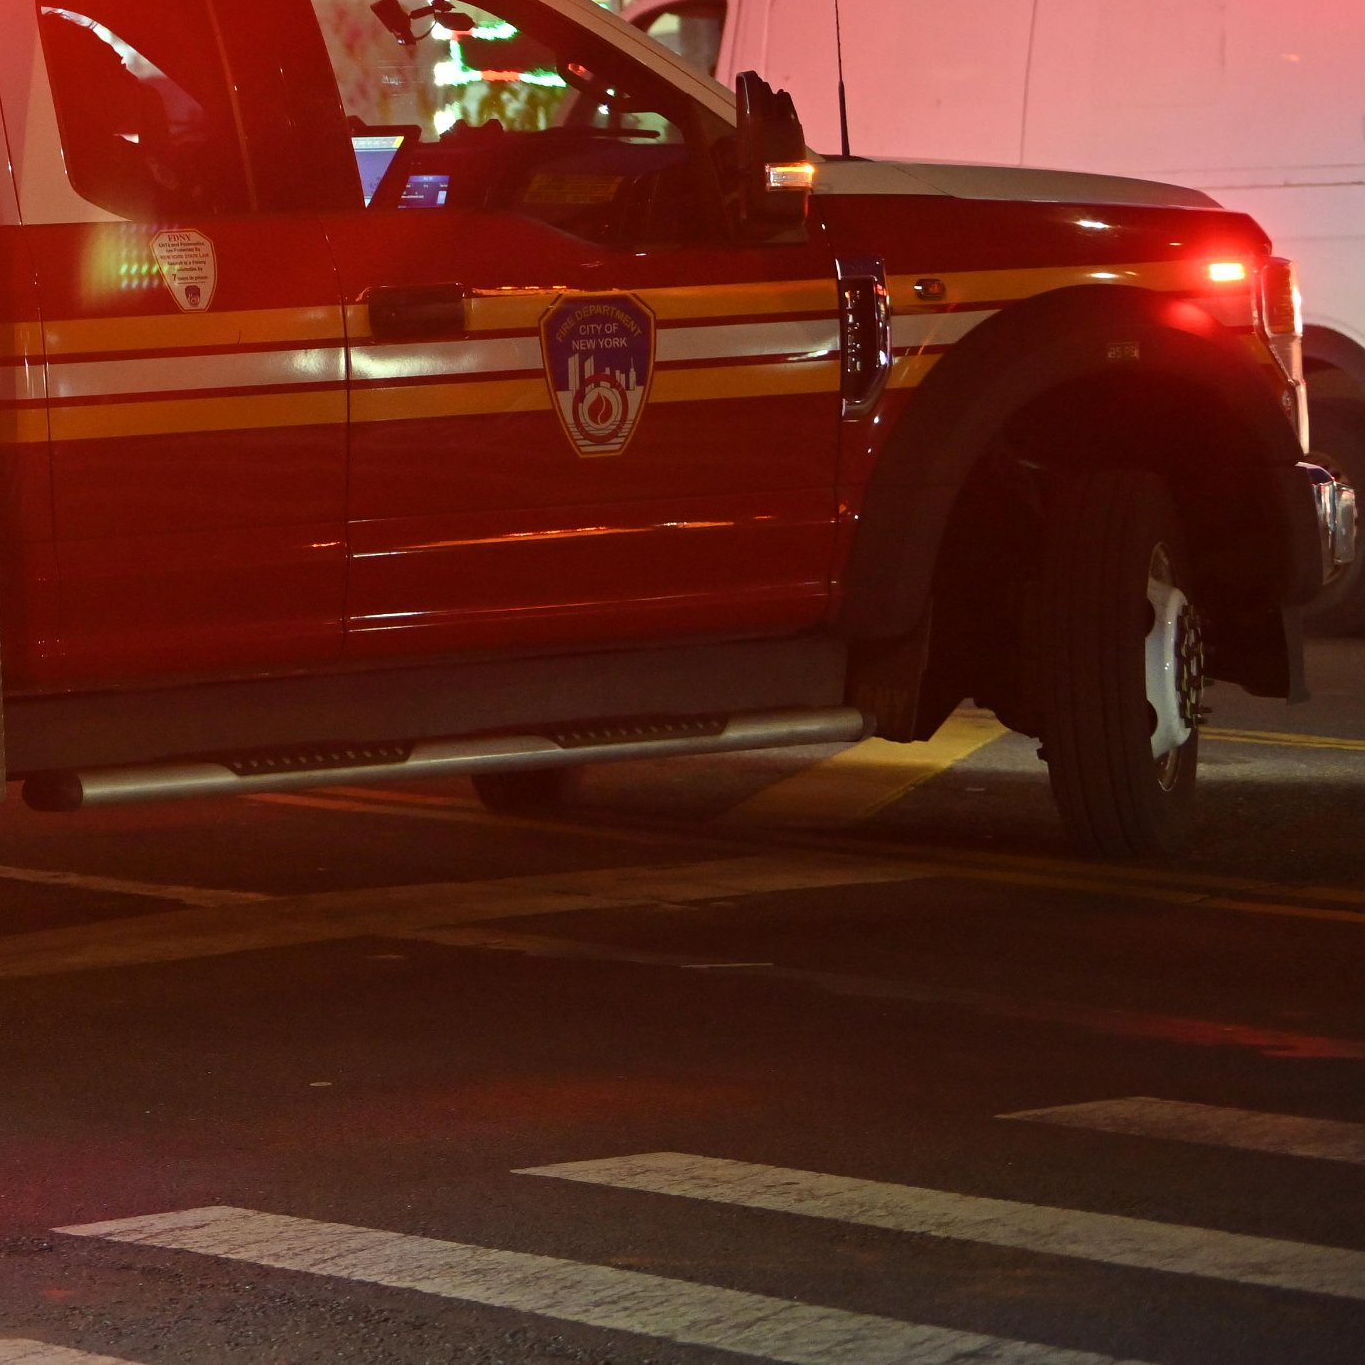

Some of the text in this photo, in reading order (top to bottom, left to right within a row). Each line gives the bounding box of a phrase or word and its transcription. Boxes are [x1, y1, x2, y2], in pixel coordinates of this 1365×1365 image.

[168, 234, 191, 242] FDNY
[555, 305, 643, 343] FIRE DEPARTMENT
[579, 322, 619, 335] CITY OF
[572, 337, 628, 351] NEW YORK
